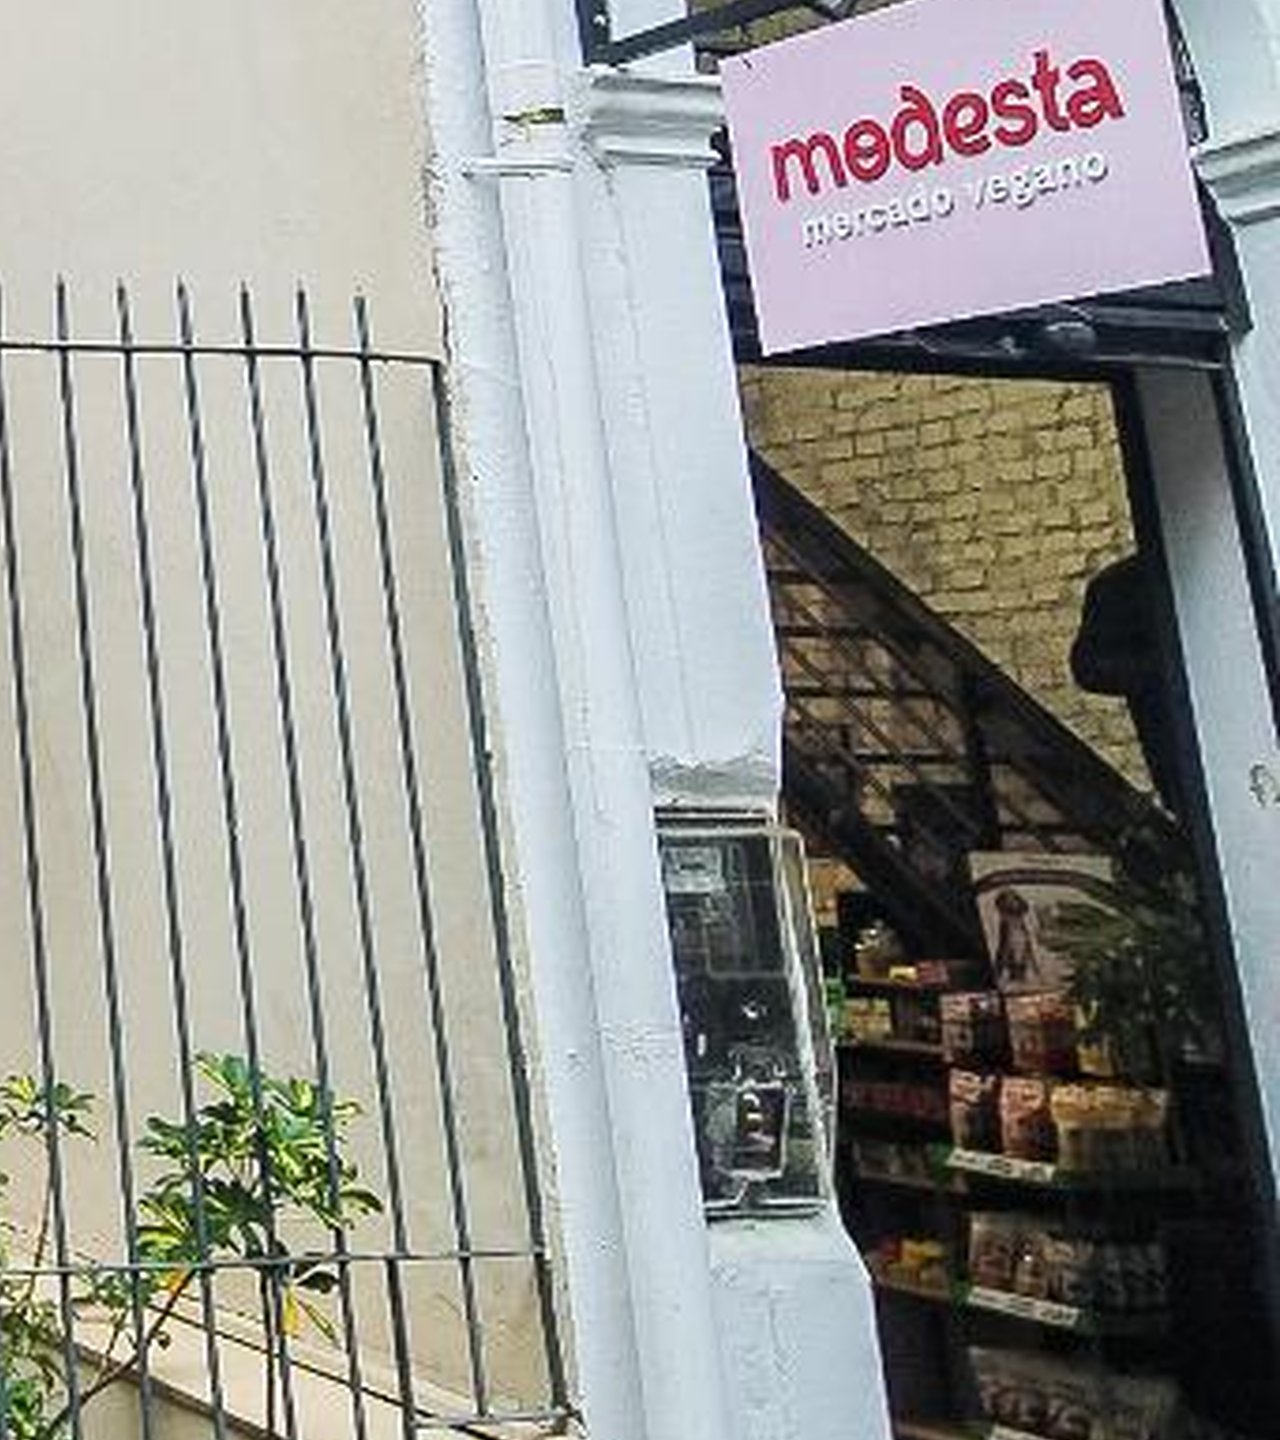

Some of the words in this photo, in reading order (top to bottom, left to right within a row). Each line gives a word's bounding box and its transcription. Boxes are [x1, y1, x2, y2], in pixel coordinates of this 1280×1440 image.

[770, 49, 1125, 203] modesta
[802, 187, 955, 249] mercado
[973, 151, 1109, 211] vegano
